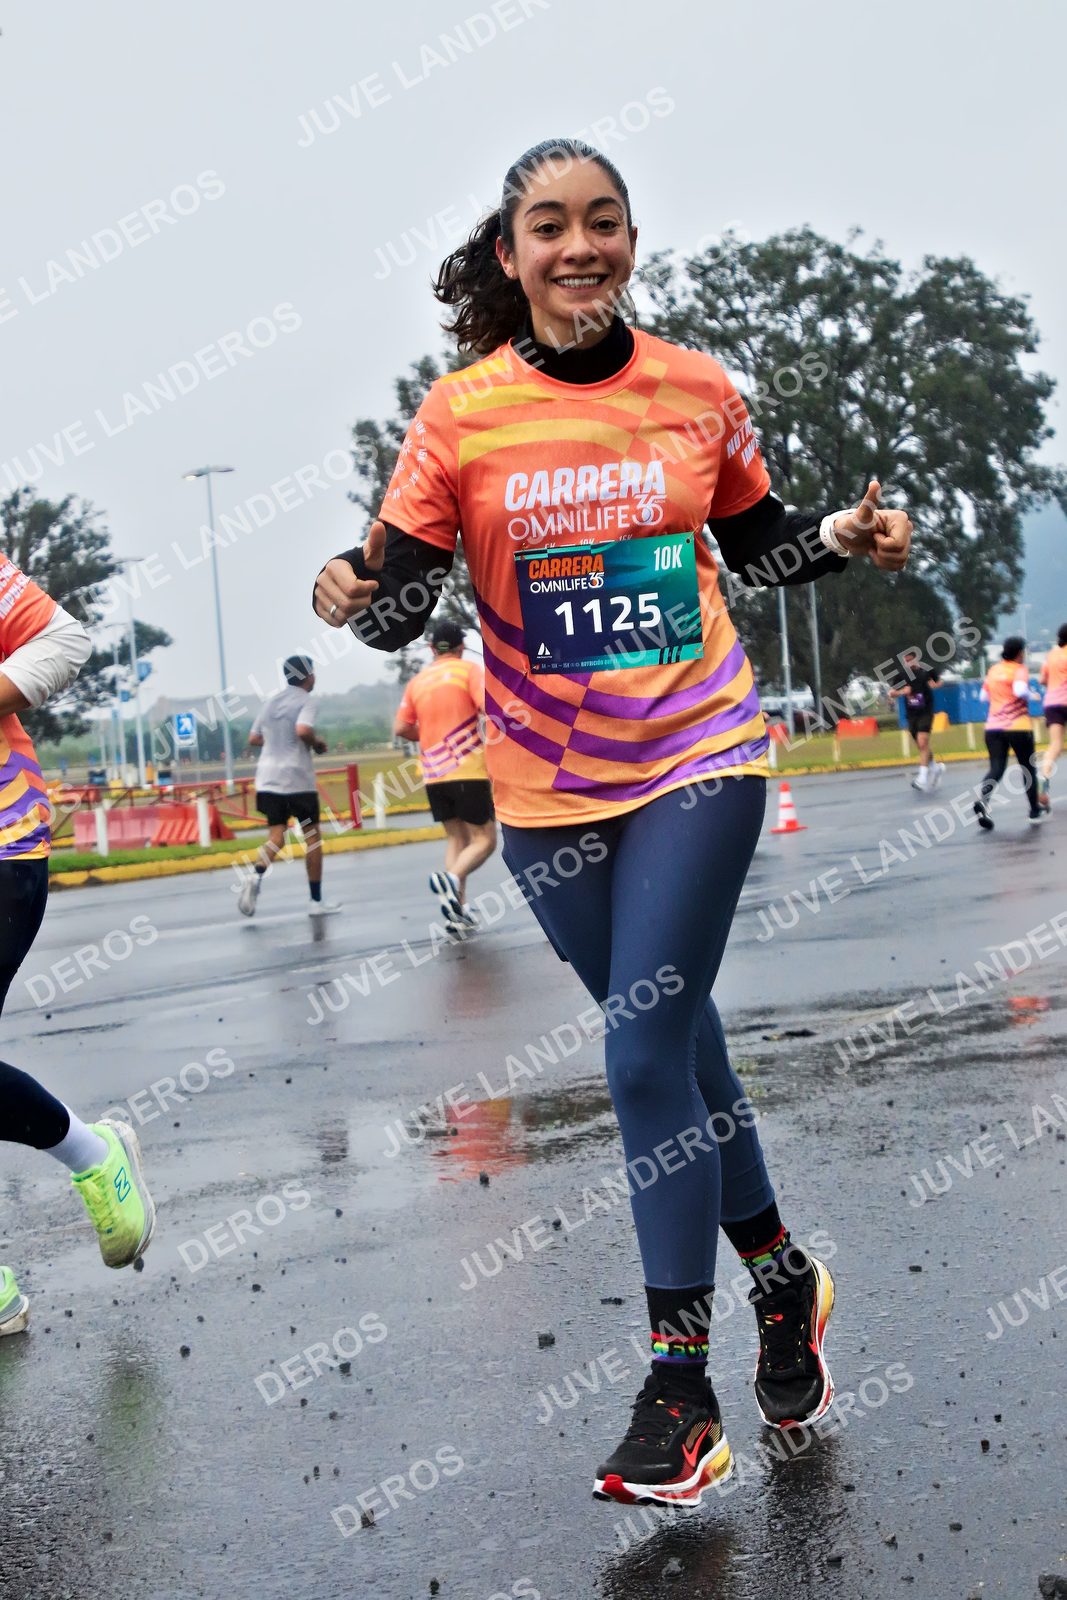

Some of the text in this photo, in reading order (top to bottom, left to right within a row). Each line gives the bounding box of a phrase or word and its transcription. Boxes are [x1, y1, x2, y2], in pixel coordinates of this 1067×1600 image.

[504, 460, 666, 512] CARRERA
[507, 504, 630, 541] OMNILIFE
[528, 554, 605, 580] CARRERA
[653, 544, 683, 572] 10K
[530, 577, 588, 594] OMNILIFE
[554, 592, 662, 636] 1125
